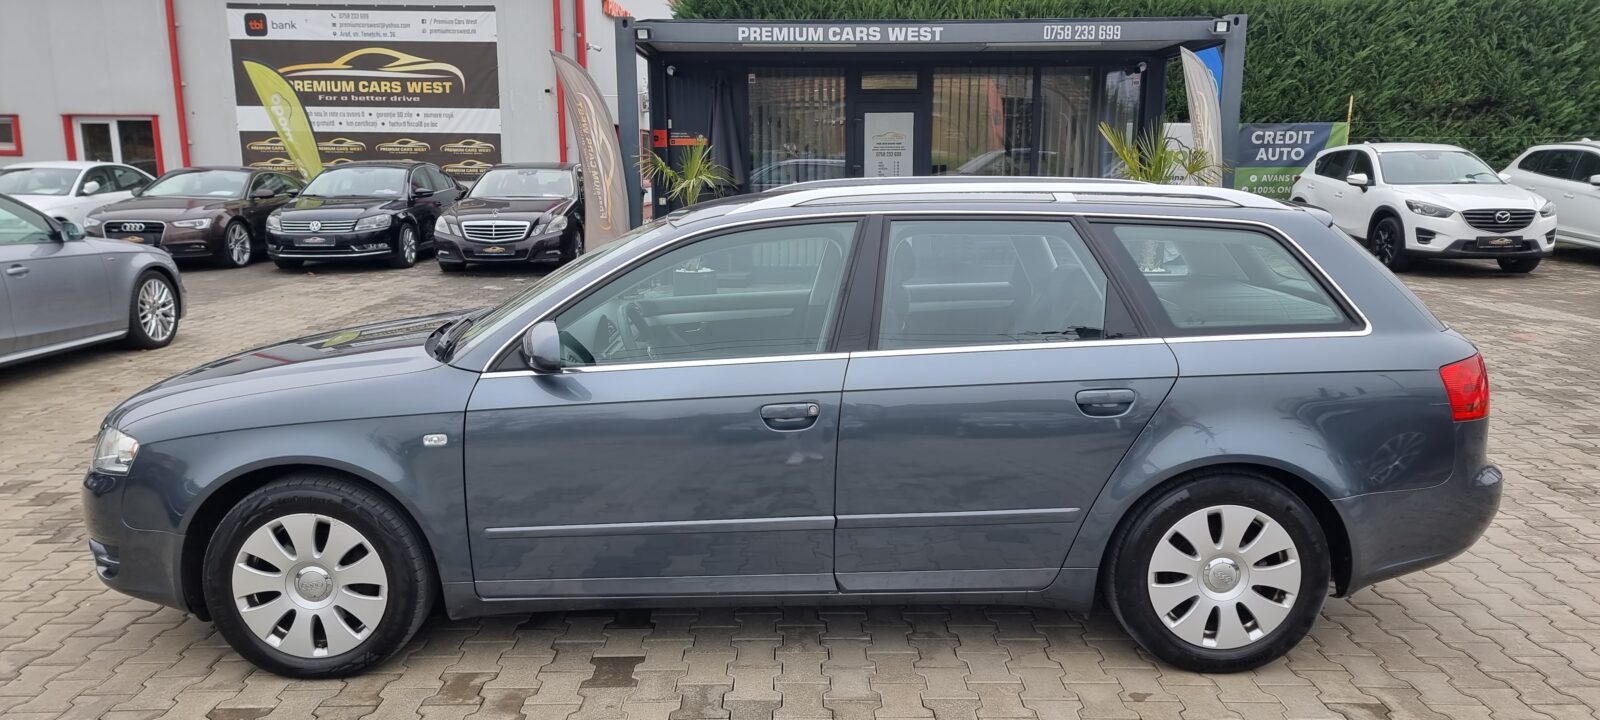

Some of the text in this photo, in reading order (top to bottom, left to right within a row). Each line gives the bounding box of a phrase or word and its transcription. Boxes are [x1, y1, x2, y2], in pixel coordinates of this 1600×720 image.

[248, 20, 297, 30] tbi bank
[738, 26, 944, 42] PREMIUM CARS WEST
[1043, 25, 1121, 40] 0758 233 699
[358, 80, 402, 93] CARS
[406, 81, 452, 94] WEST
[351, 94, 388, 102] better
[1251, 130, 1315, 145] CREDIT
[1255, 147, 1305, 161] AUTO
[1261, 174, 1290, 182] AVANS
[1253, 186, 1276, 194] 100%
